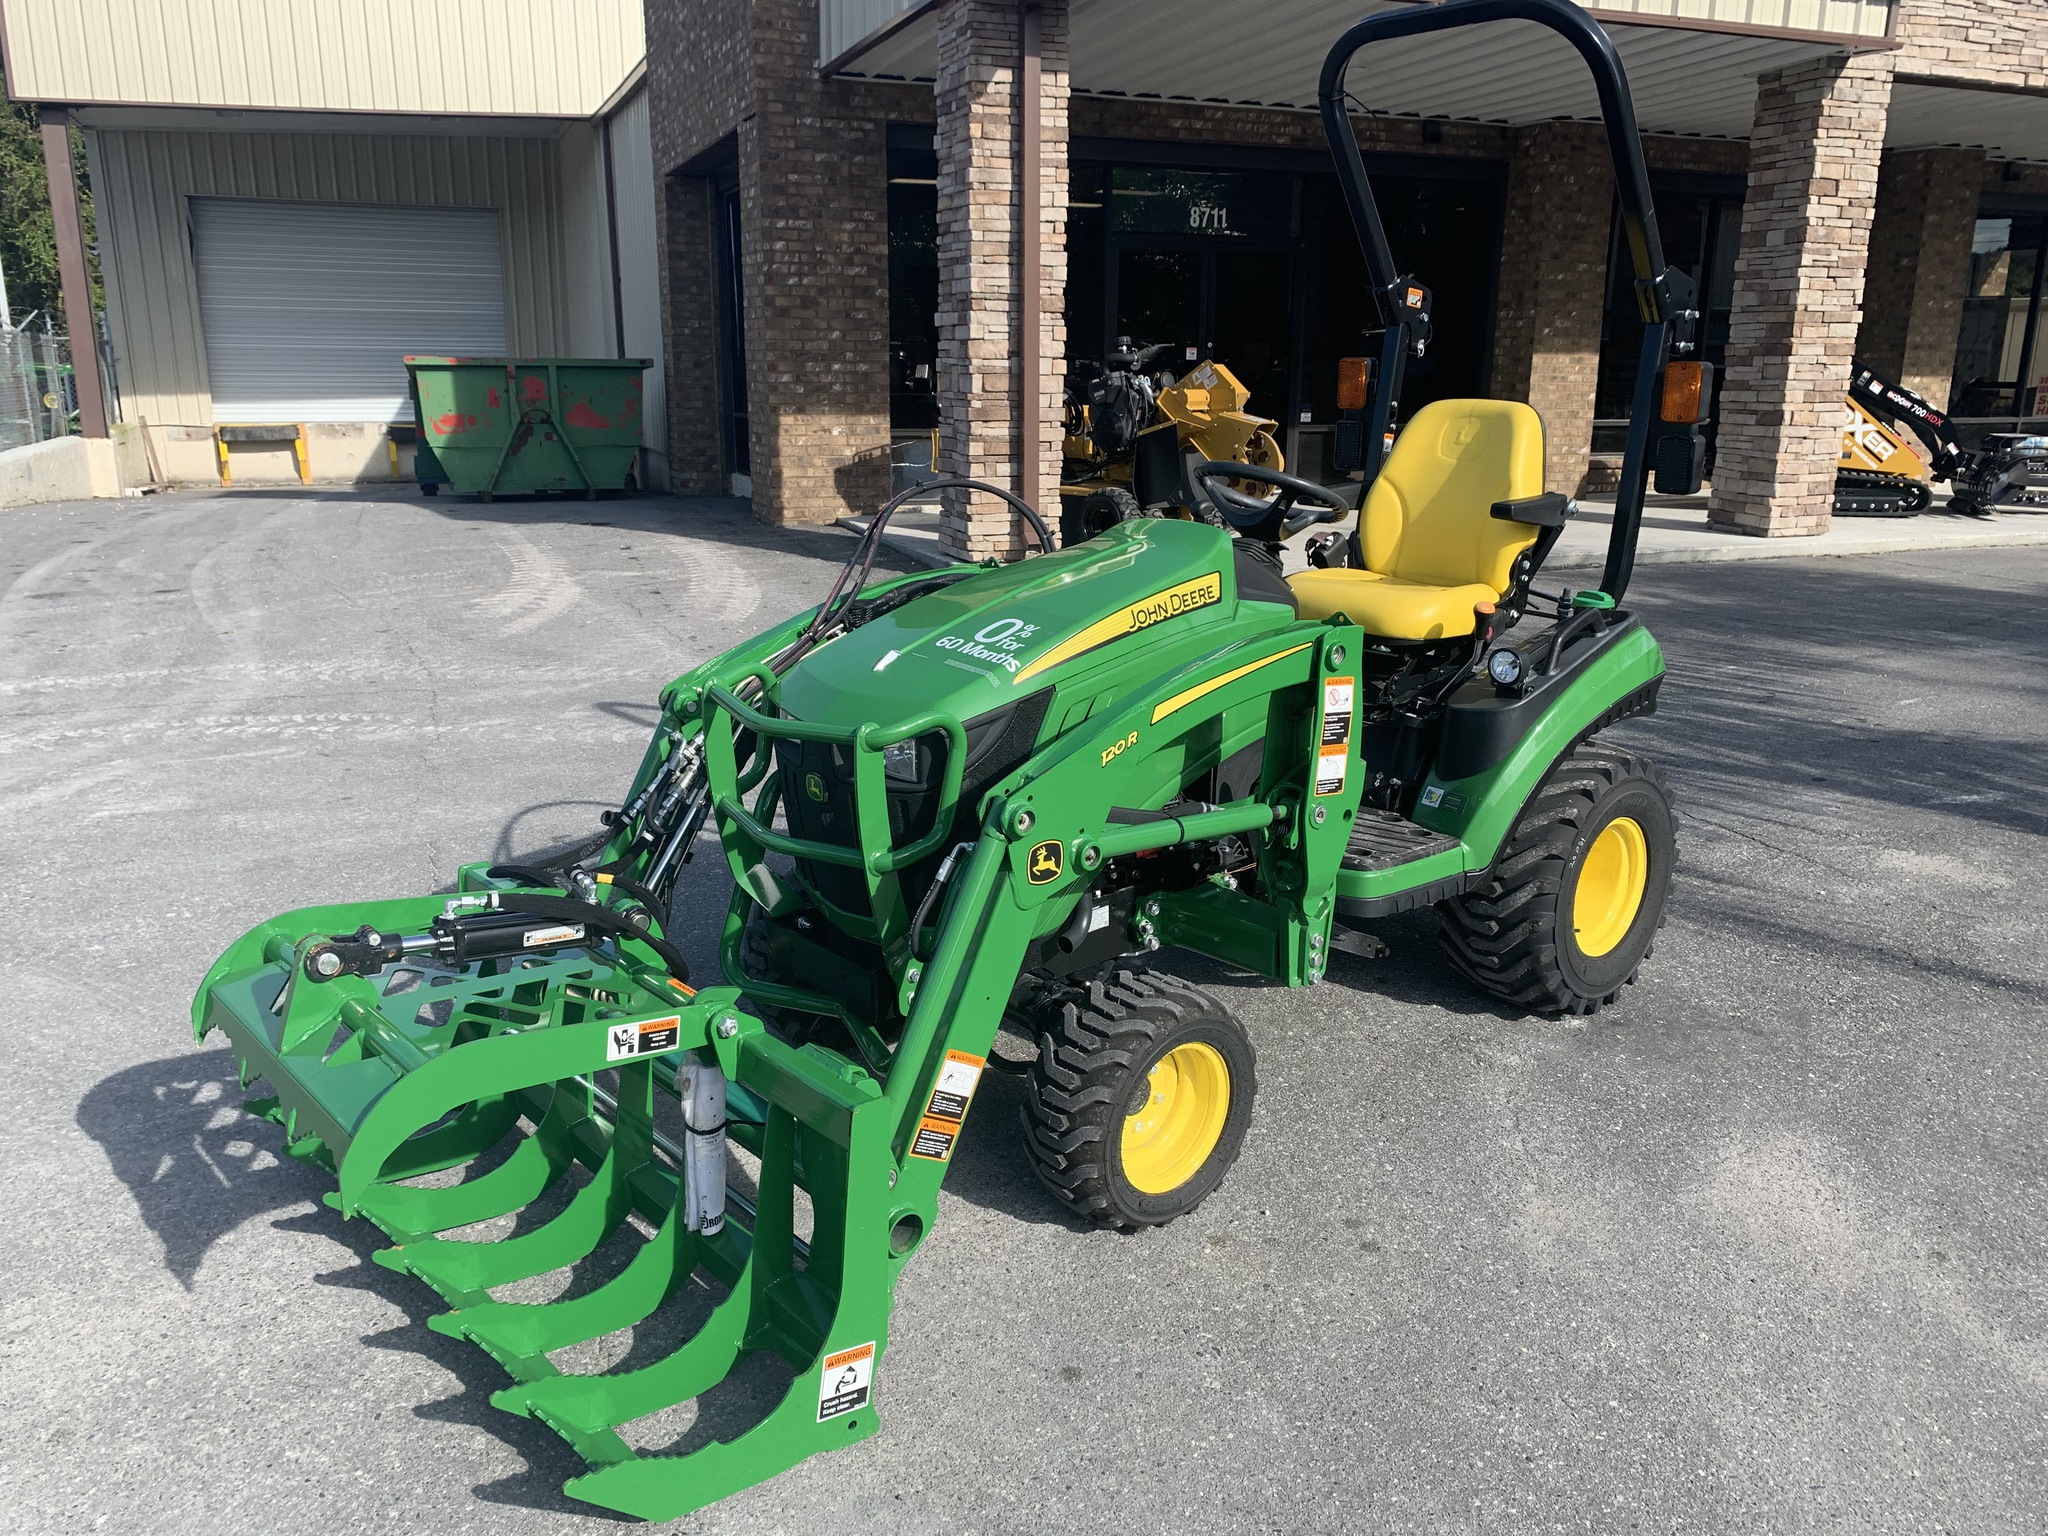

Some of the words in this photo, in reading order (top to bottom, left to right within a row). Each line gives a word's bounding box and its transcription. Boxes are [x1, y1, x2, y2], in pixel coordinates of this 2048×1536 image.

[1190, 206, 1227, 229] 8711
[1886, 390, 1912, 409] BOXER
[1844, 407, 1896, 462] OXER
[1843, 438, 1854, 447] BY
[1851, 445, 1878, 470] MORBARK
[1129, 600, 1169, 629] JOHN
[1169, 584, 1216, 613] DEERE
[995, 636, 1025, 651] for
[935, 636, 965, 650] 60
[956, 641, 1022, 673] Months
[648, 1020, 676, 1030] WARNING
[956, 1055, 981, 1066] WARNING
[930, 1123, 956, 1133] WARNING
[835, 1347, 871, 1365] WARNING
[822, 1407, 837, 1416] Keep
[823, 1399, 840, 1408] Crush
